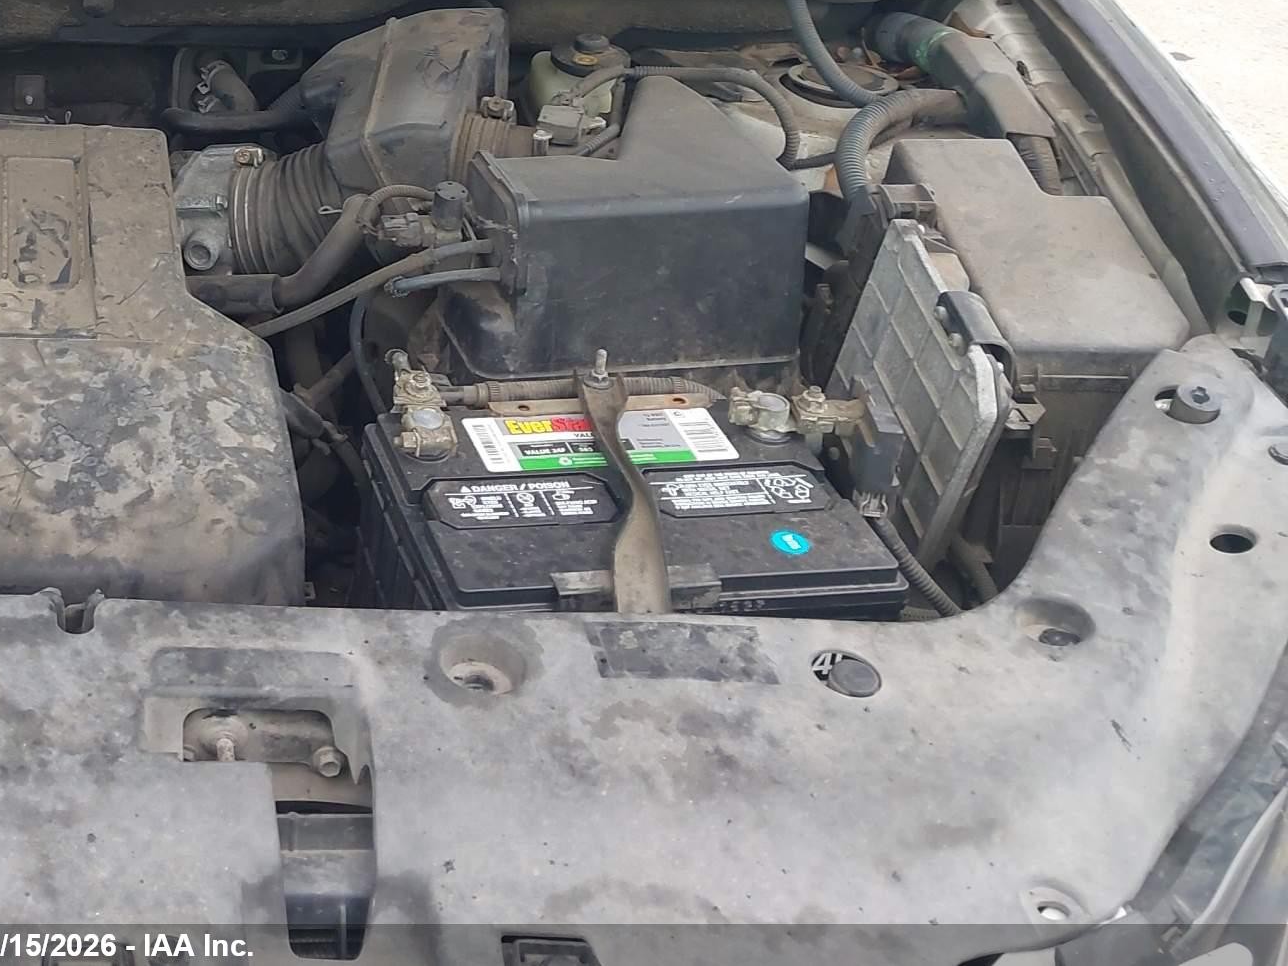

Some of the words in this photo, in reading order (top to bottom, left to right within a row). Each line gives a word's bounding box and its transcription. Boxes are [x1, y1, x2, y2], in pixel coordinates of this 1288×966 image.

[504, 417, 593, 435] EverSta
[470, 484, 519, 494] DANGER
[528, 481, 571, 490] POISON
